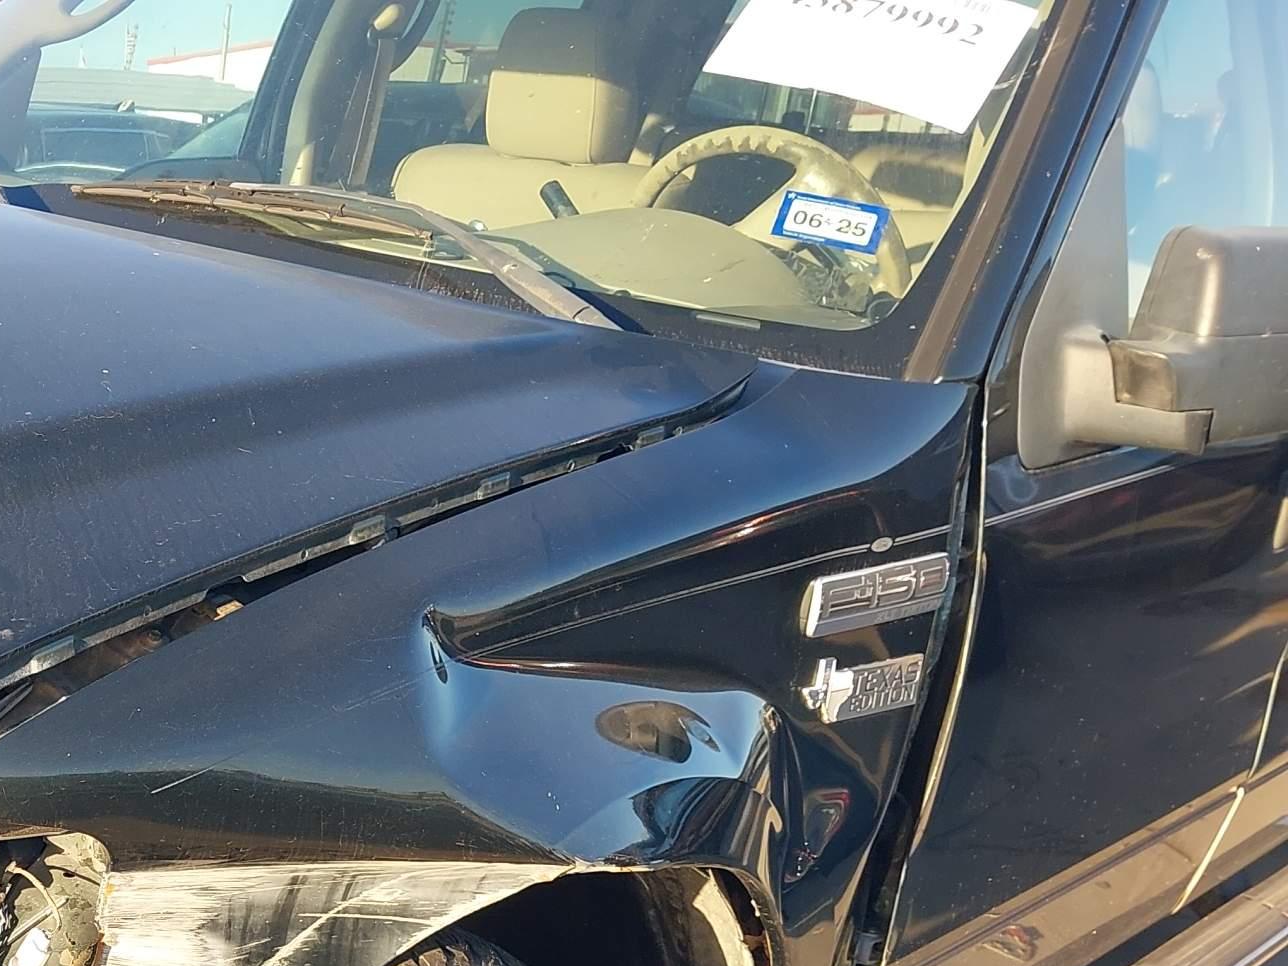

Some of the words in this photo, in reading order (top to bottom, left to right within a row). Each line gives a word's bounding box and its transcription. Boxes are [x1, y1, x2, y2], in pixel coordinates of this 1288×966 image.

[792, 0, 984, 45] 879992
[854, 660, 920, 696] TEXAS
[850, 684, 917, 712] EDITION
